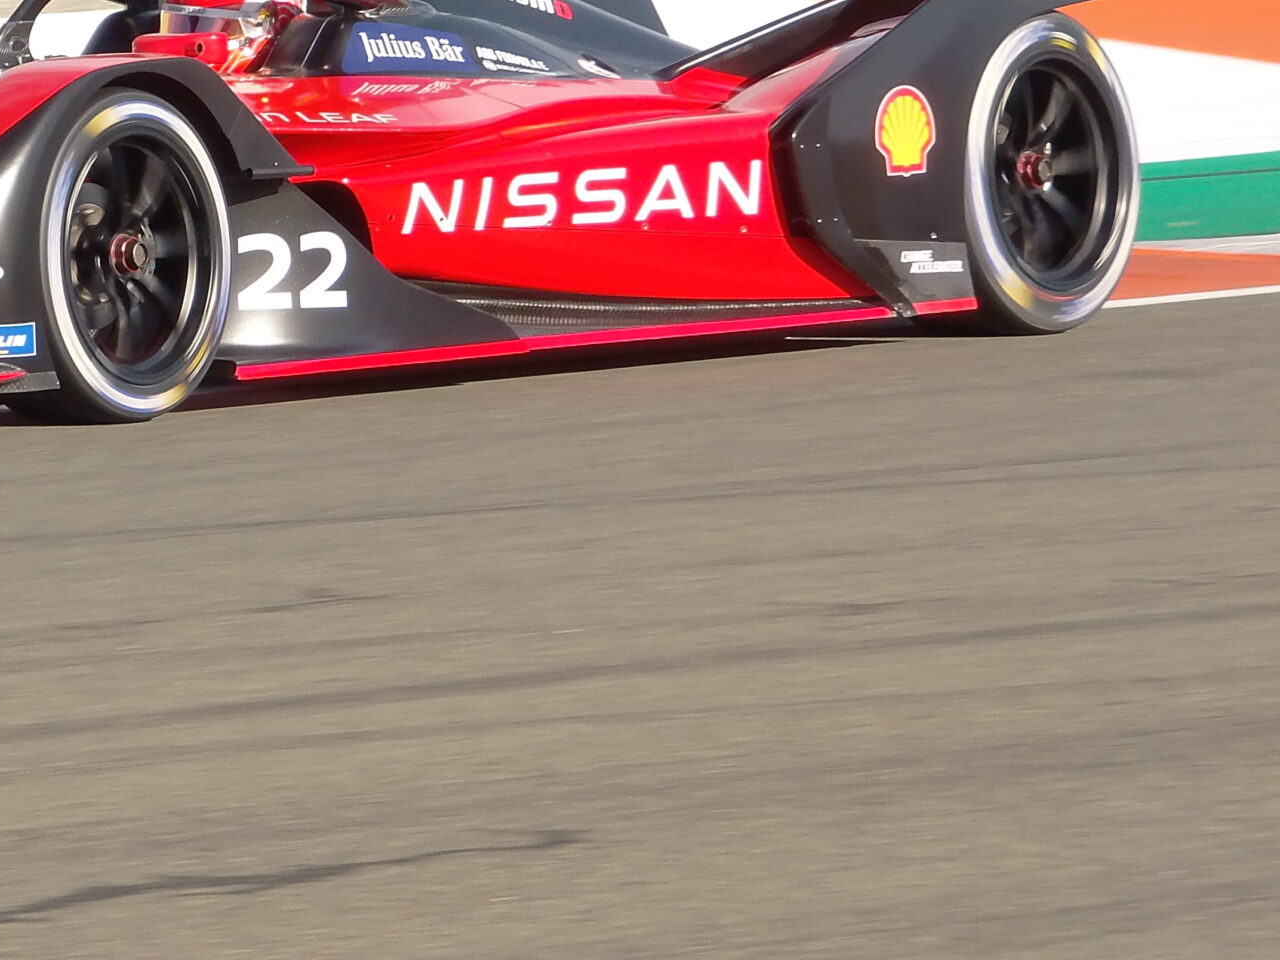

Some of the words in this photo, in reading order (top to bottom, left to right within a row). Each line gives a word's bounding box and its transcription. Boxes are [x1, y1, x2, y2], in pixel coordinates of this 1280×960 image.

[359, 32, 425, 63] Julius
[424, 36, 466, 63] Bär
[295, 111, 398, 124] LEAF
[400, 160, 762, 236] NISSAN
[236, 231, 348, 311] 22
